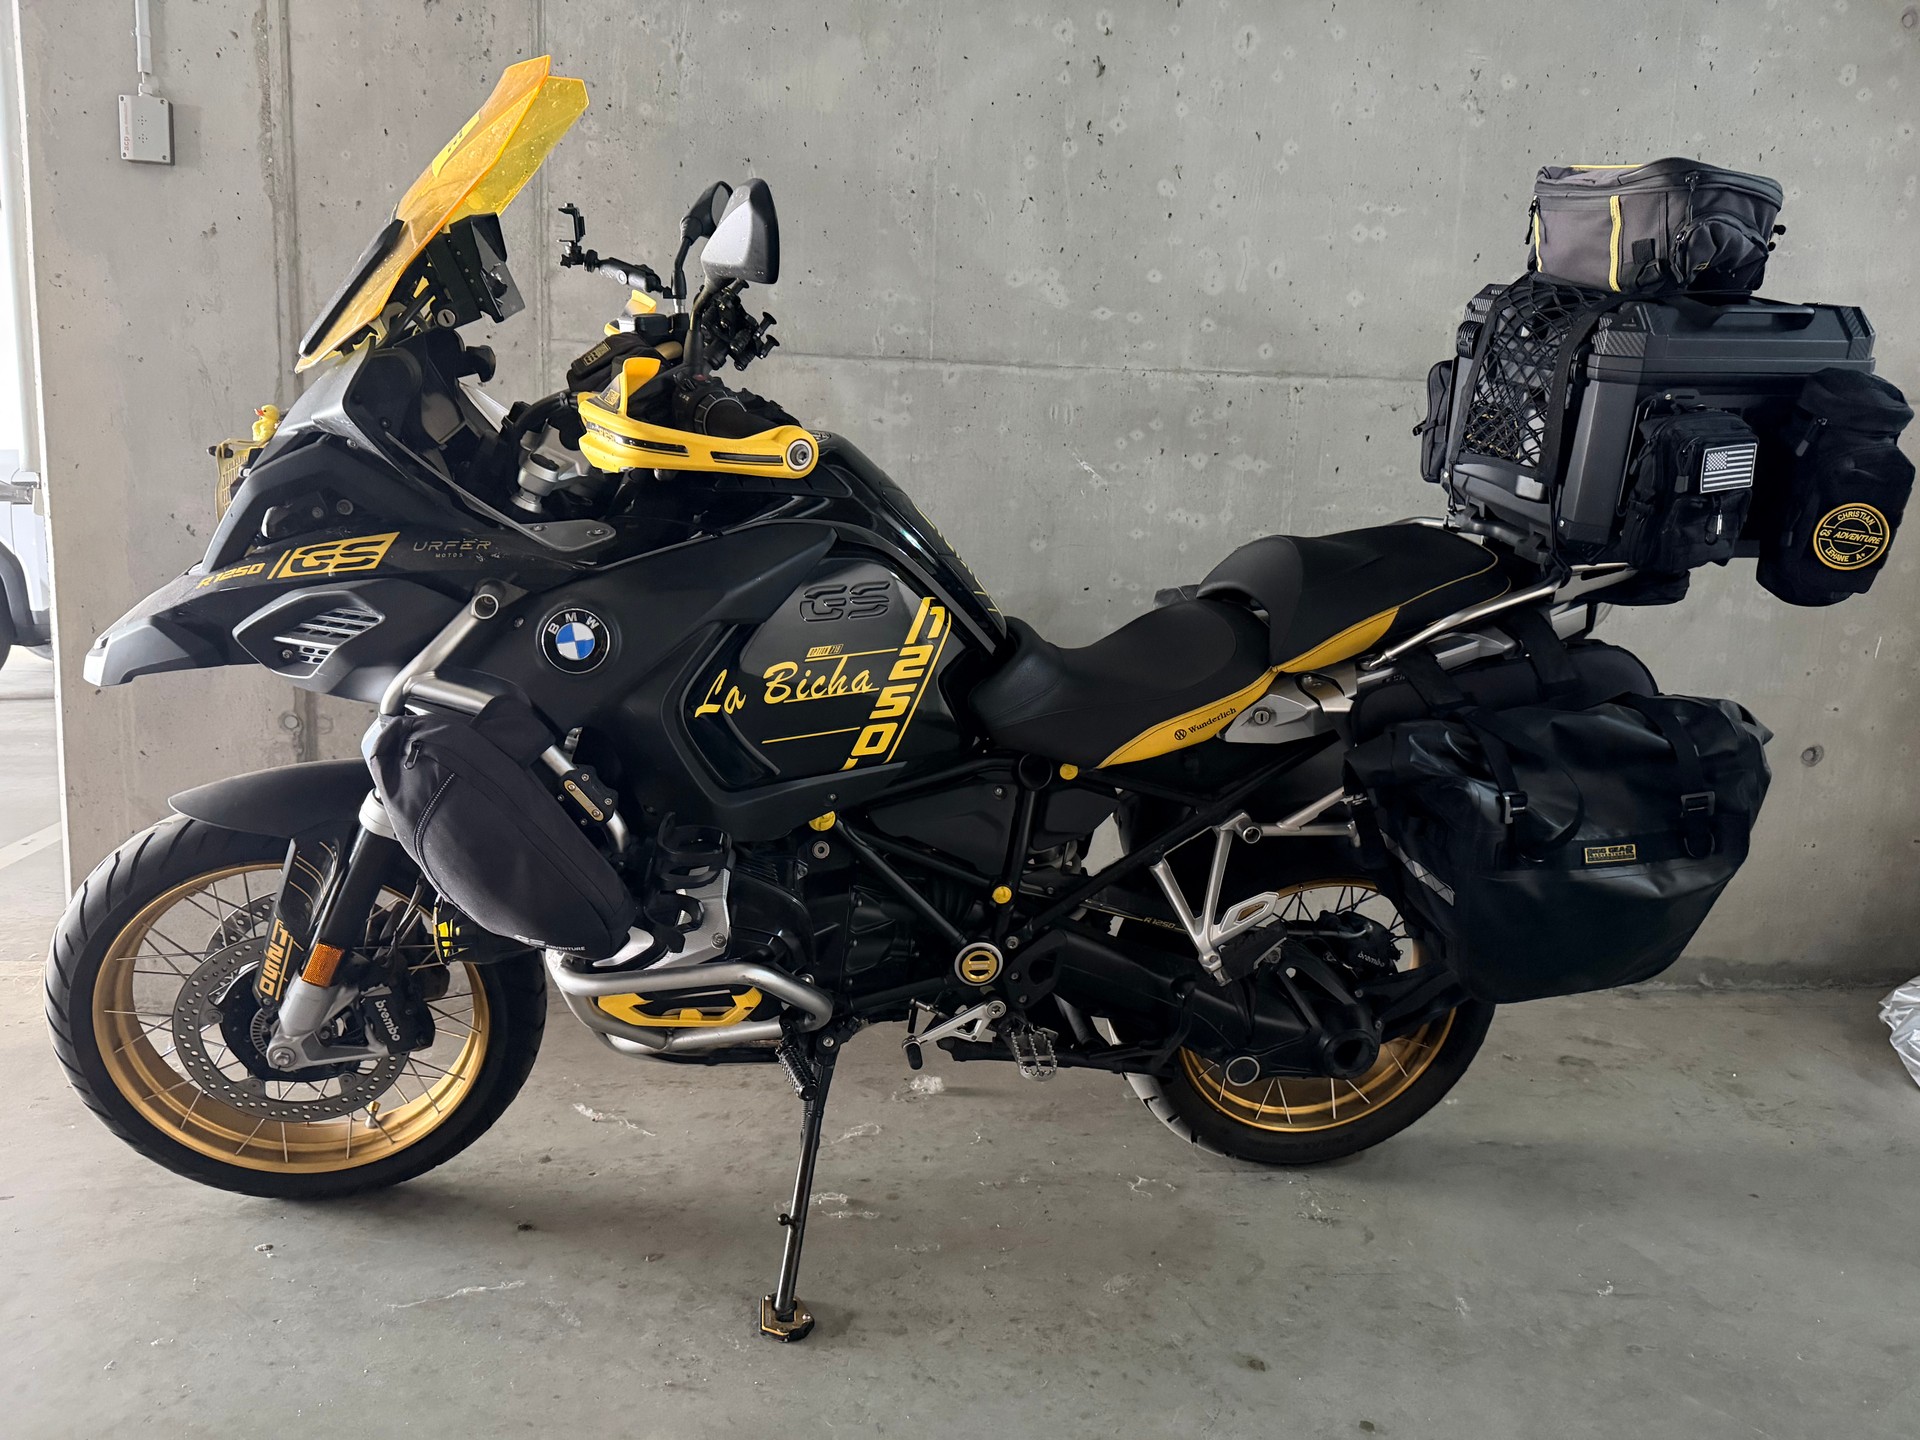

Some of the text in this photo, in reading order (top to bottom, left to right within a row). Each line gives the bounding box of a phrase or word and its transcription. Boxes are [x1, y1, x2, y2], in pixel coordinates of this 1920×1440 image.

[1837, 510, 1876, 526] CHRISTIAN
[413, 540, 492, 551] URFER
[1819, 529, 1883, 544] GS ADVENTURE
[290, 540, 387, 573] GS
[1825, 547, 1850, 562] LEHANE
[800, 581, 891, 623] GS
[547, 612, 600, 635] BMW
[694, 656, 880, 719] La Bicha
[851, 605, 946, 757] 1250
[1188, 707, 1237, 734] Wunderlich
[375, 999, 401, 1041] brembo
